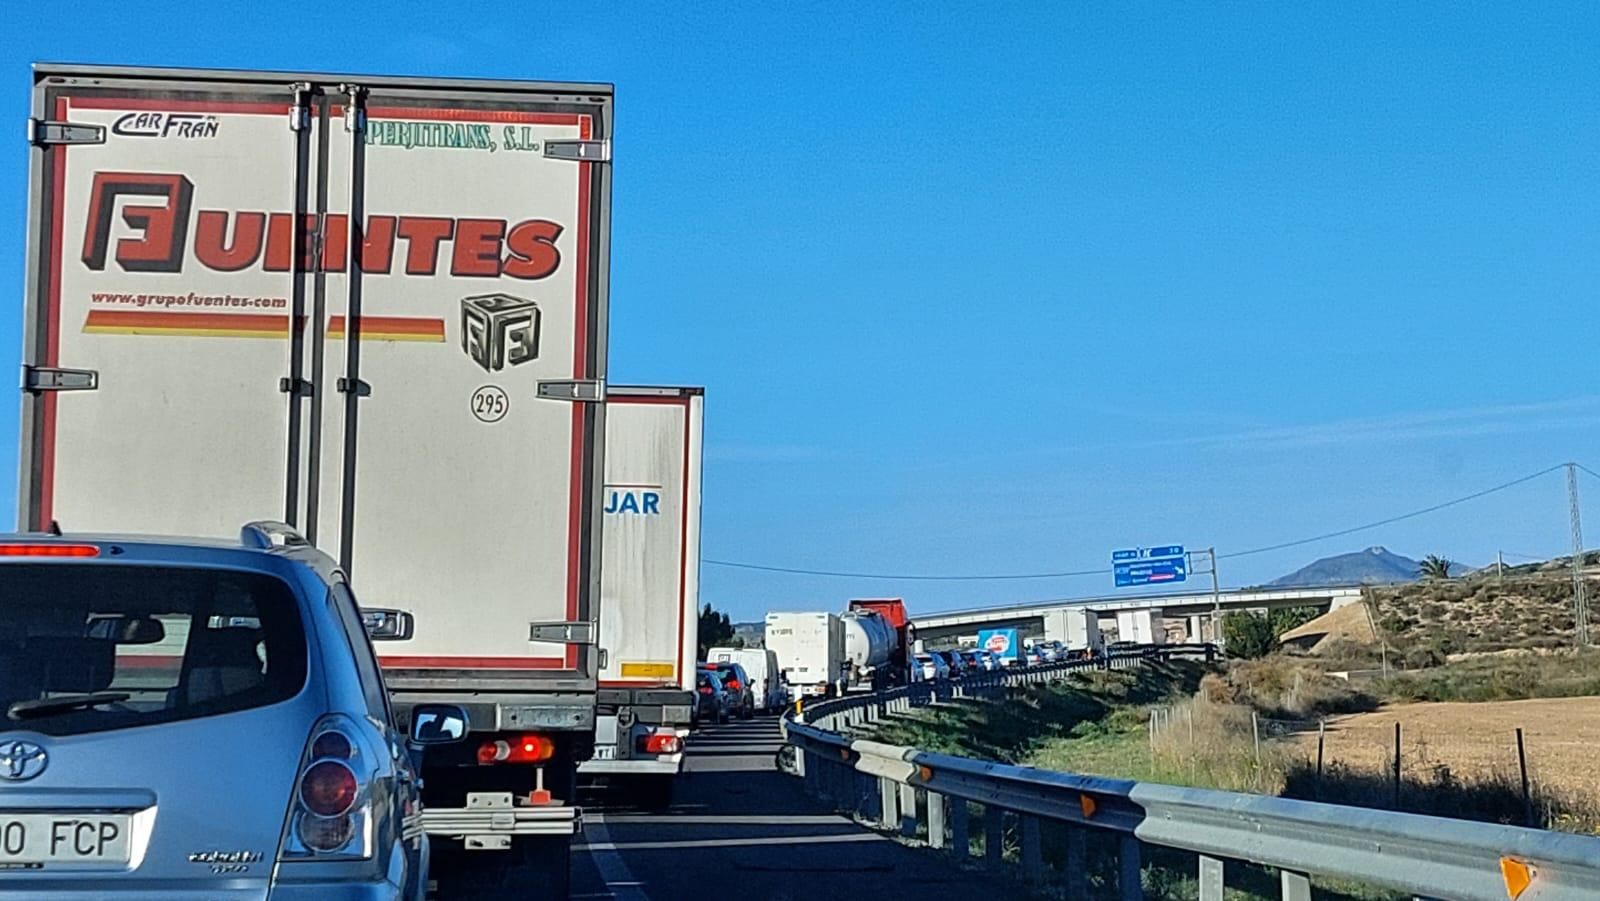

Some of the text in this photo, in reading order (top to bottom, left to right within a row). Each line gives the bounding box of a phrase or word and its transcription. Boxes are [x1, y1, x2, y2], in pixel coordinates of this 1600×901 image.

[81, 170, 564, 280] FUENTES
[91, 292, 287, 308] www.grupofuentes.com
[476, 393, 504, 414] 295
[604, 491, 660, 514] JAR
[0, 820, 119, 856] 0 FCP
